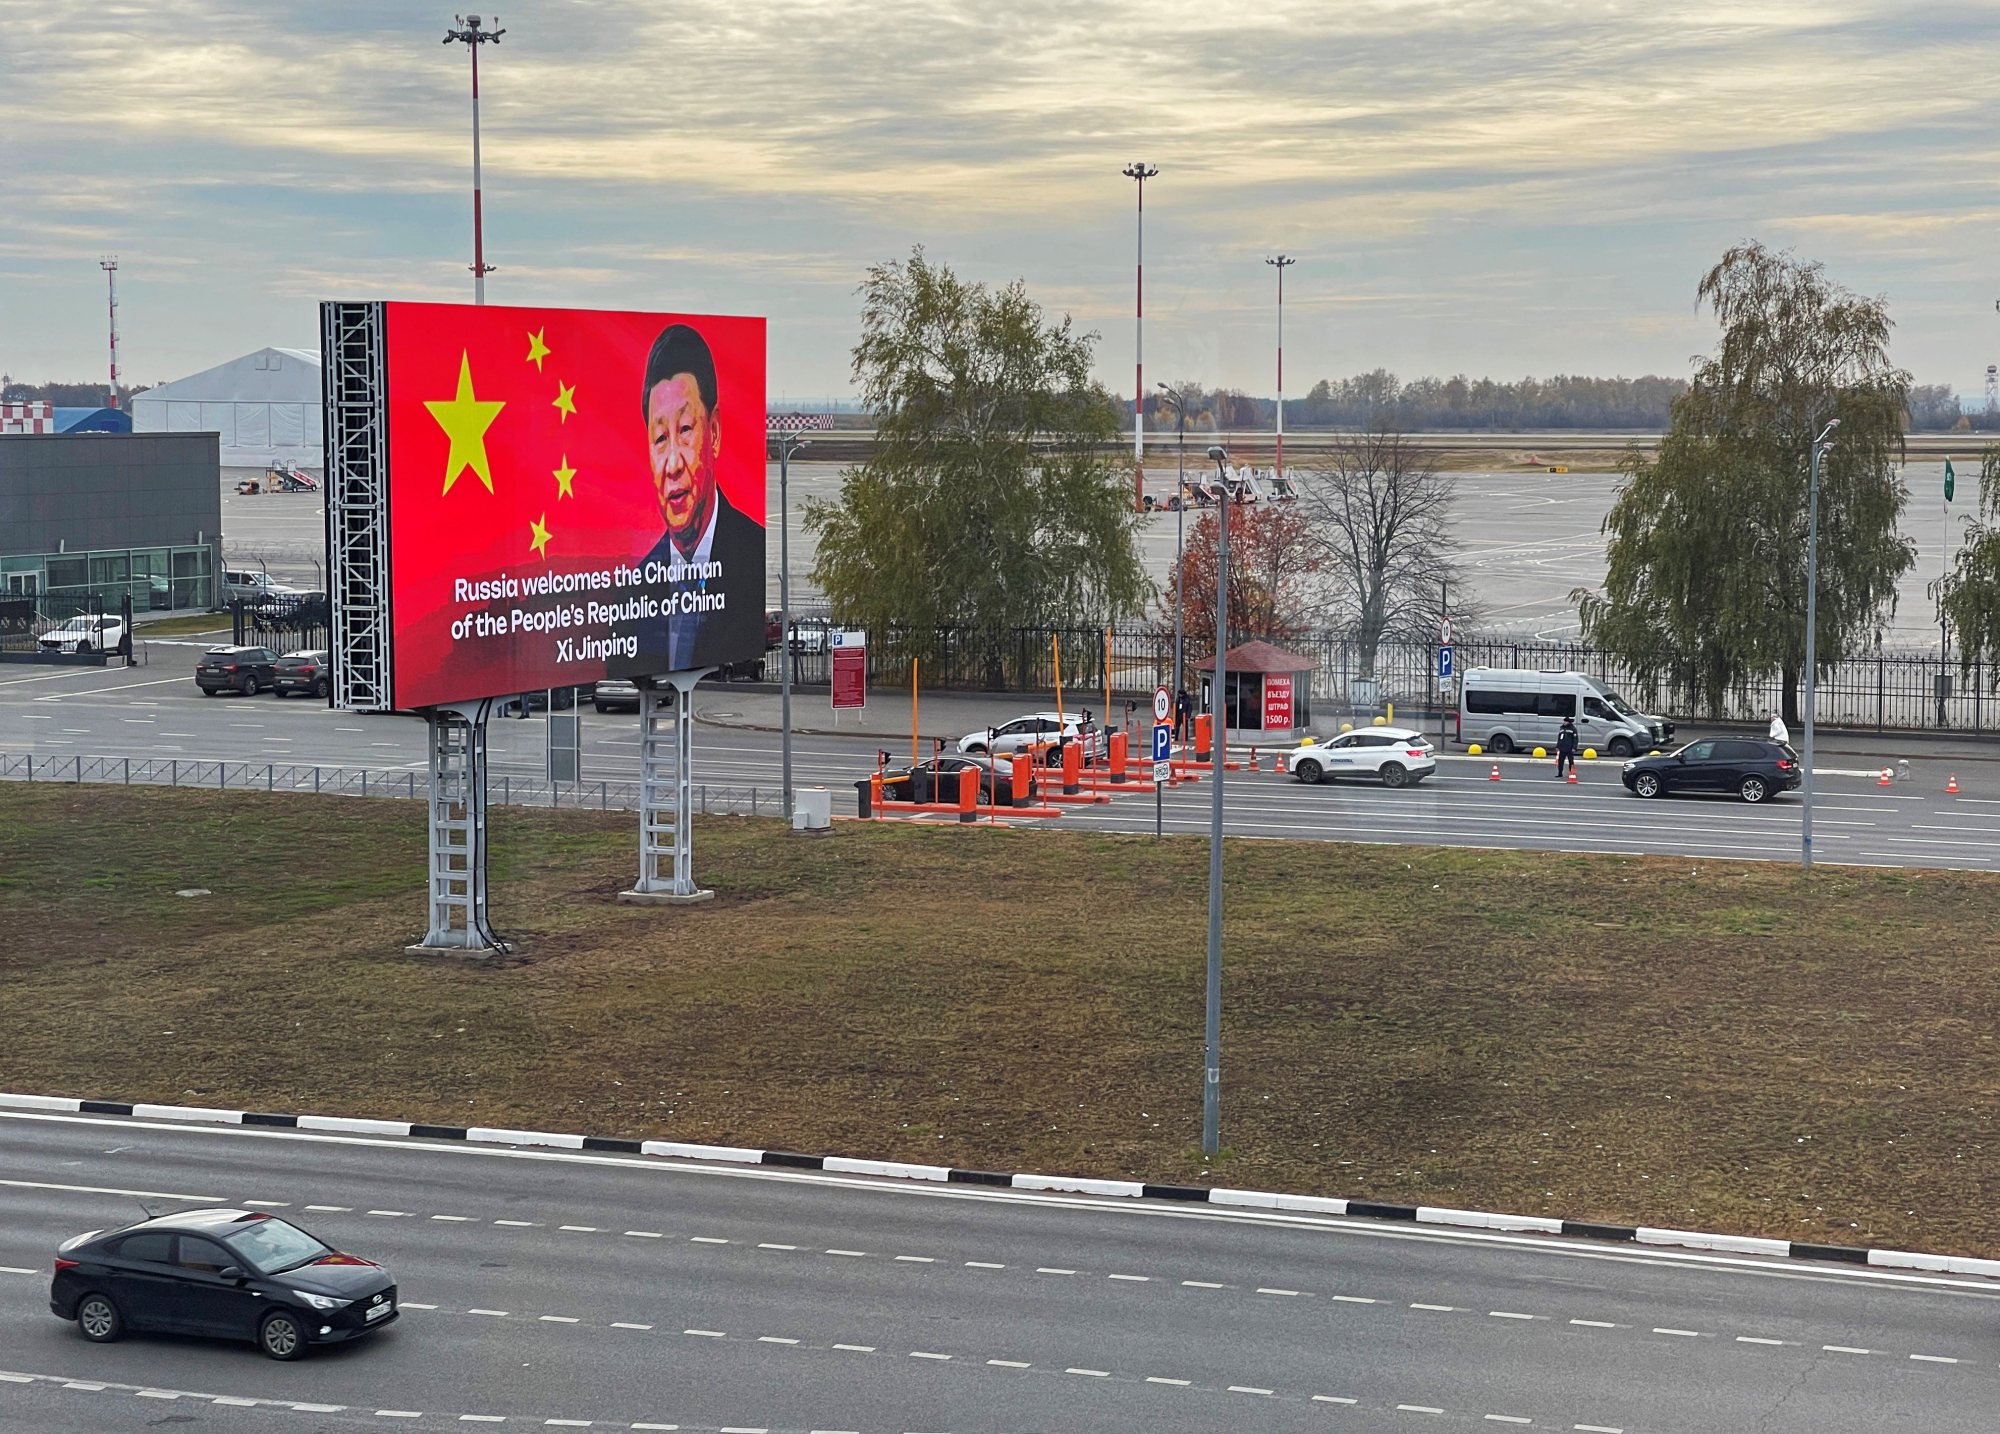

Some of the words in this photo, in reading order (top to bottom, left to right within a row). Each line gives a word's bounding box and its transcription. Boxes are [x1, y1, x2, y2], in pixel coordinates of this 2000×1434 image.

[454, 573, 518, 602] Russia
[522, 570, 611, 597] welcomes
[614, 564, 642, 587] the
[644, 559, 722, 584] Chairman
[451, 614, 473, 640] of
[475, 612, 508, 637] the
[511, 604, 584, 636] People’s
[587, 593, 658, 627] Republic
[661, 591, 679, 616] of
[680, 589, 725, 614] China
[556, 638, 573, 663] Xi
[575, 632, 638, 662] Jinping
[835, 635, 841, 645] P
[1442, 651, 1450, 673] P
[1158, 698, 1166, 712] 10
[1266, 715, 1282, 724] 1500
[1158, 729, 1167, 757] P
